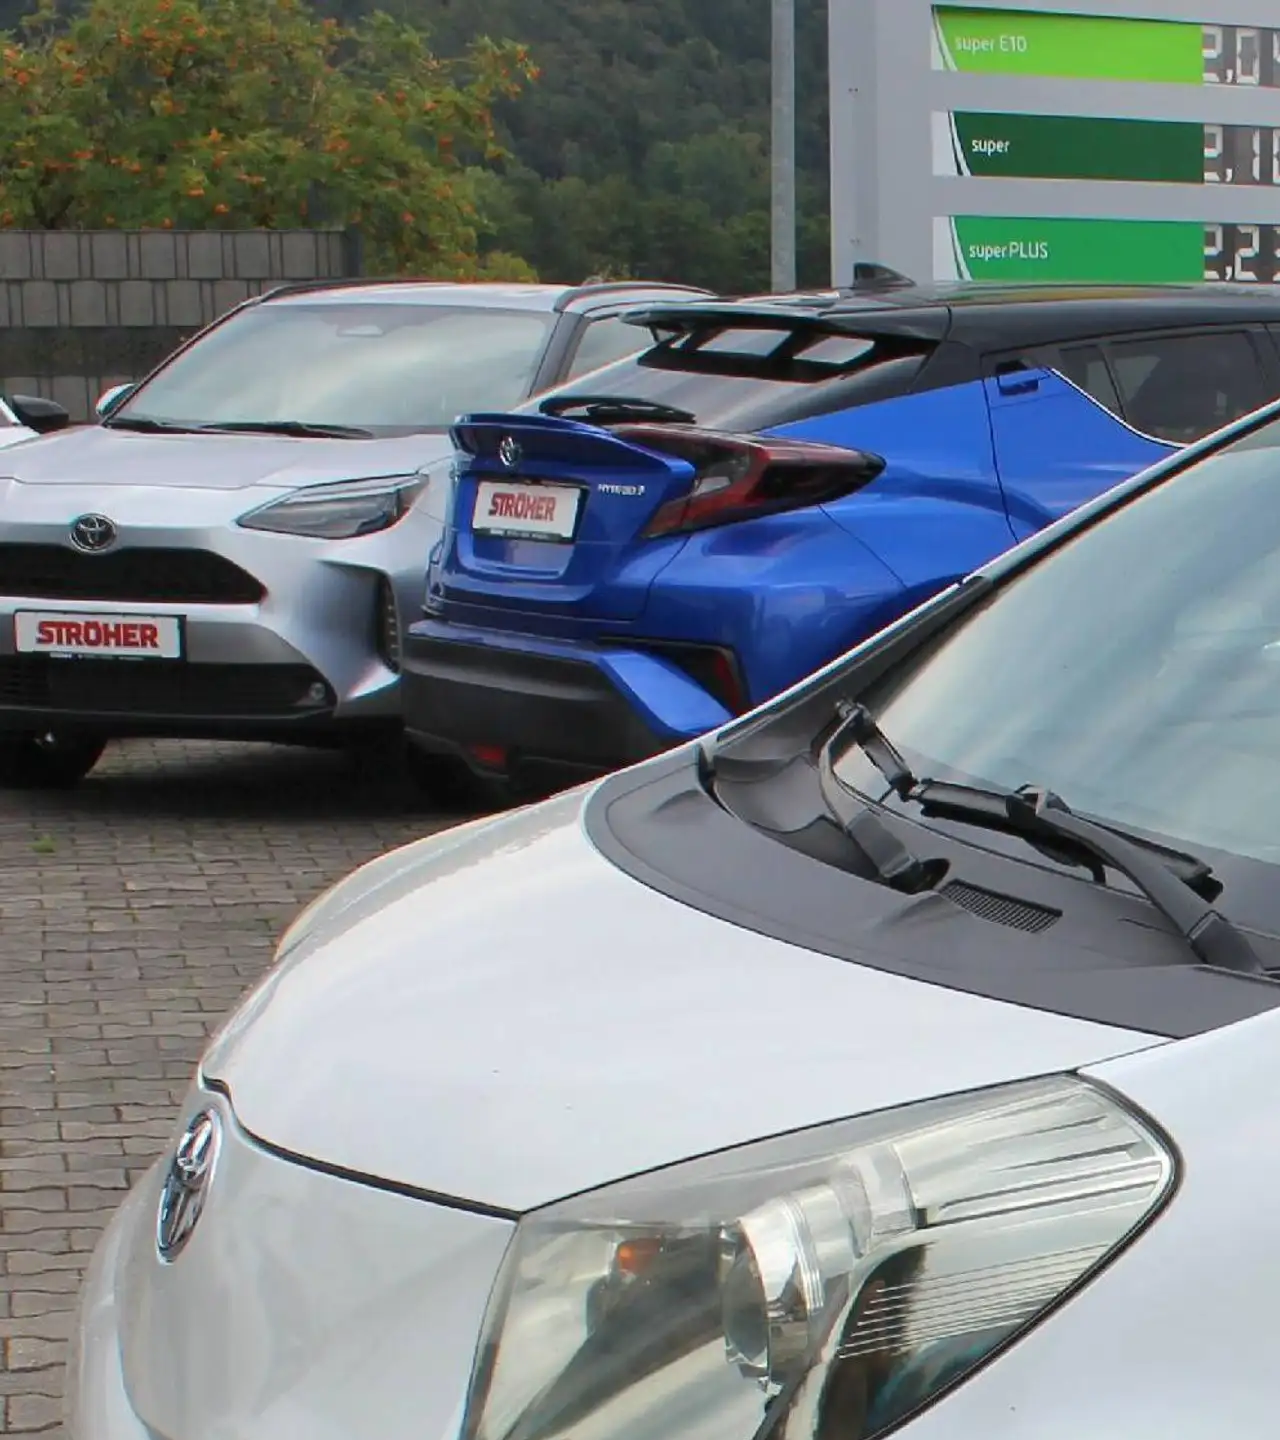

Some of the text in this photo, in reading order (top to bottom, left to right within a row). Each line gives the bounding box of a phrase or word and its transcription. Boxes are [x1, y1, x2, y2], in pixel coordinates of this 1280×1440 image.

[955, 36, 994, 56] super
[1000, 35, 1027, 52] E10
[971, 139, 1010, 156] super
[488, 491, 556, 521] STRÖHER
